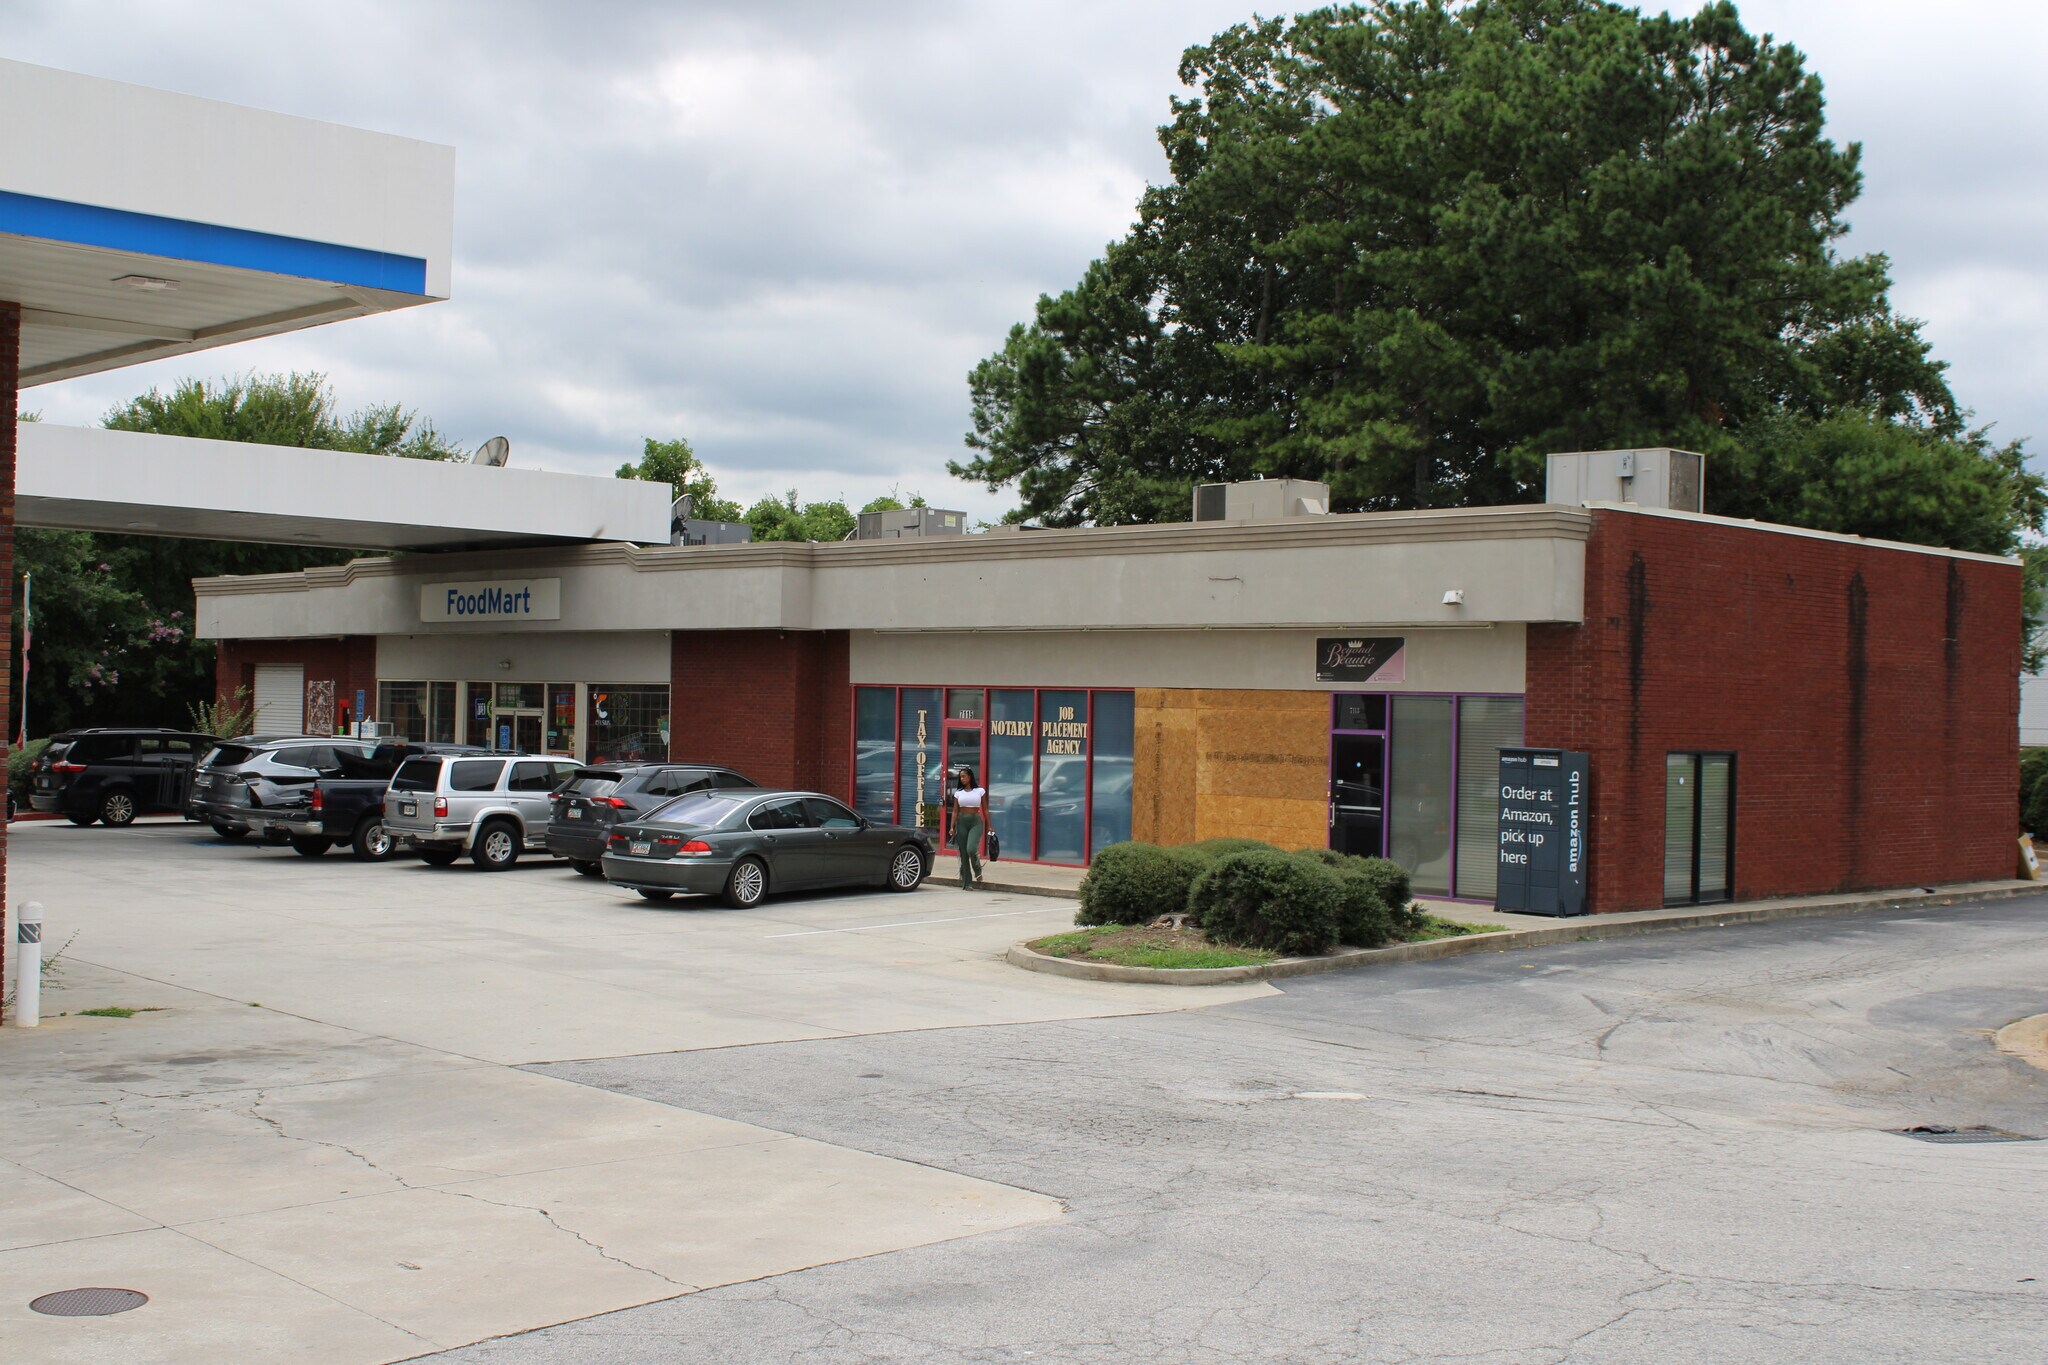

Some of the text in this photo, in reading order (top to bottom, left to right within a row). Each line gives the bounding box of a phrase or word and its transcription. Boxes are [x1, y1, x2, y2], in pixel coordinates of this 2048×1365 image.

[447, 586, 531, 615] FoodMart
[1322, 642, 1376, 664] Beyond
[1330, 654, 1375, 668] Beautie
[1058, 706, 1074, 722] JOB
[991, 720, 1033, 737] NOTARY
[1042, 721, 1088, 738] PLACEMENT
[1046, 739, 1081, 755] AGENCY
[915, 710, 927, 828] TAX OFFICE
[1502, 785, 1553, 802] Order at
[1502, 807, 1553, 826] Amazon,
[1569, 770, 1580, 873] amazon hub
[1501, 828, 1544, 847] pick up
[1501, 849, 1527, 864] here
